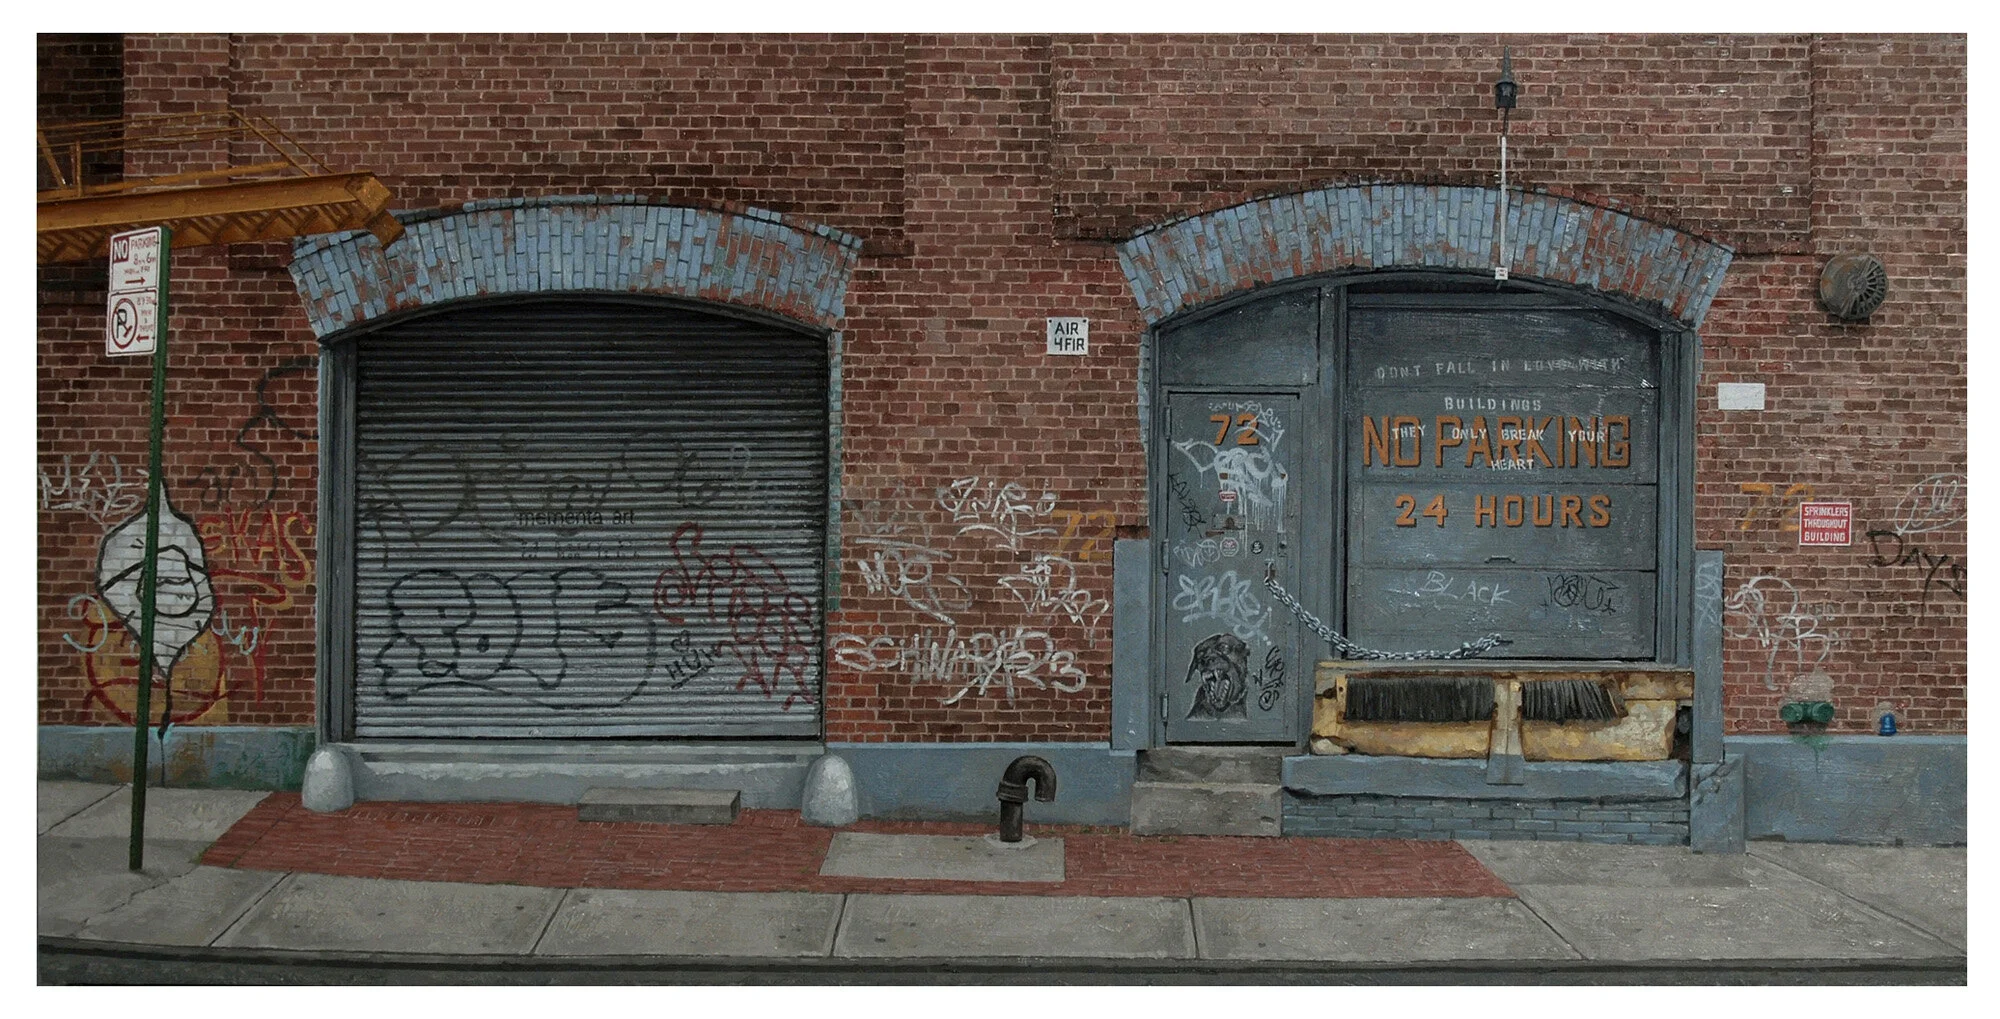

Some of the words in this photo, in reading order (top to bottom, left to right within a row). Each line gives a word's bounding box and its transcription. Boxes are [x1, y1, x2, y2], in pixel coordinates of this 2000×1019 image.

[113, 239, 128, 261] NO
[1055, 322, 1079, 335] AIR
[1054, 337, 1085, 351] 4FIR
[1436, 361, 1476, 376] FALL
[1492, 360, 1510, 373] IN
[1444, 397, 1542, 411] BUILDINGS
[1210, 414, 1260, 446] 72
[1392, 425, 1426, 439] THEY
[1451, 427, 1487, 440] ONLY
[1501, 428, 1545, 441] BREAK
[1568, 429, 1606, 443] YOUR
[1363, 415, 1421, 467] NO
[1435, 415, 1631, 468] PARKING
[1491, 458, 1535, 471] HEART
[1394, 494, 1448, 527] 24
[1475, 494, 1612, 528] HOURS
[1741, 483, 1815, 532] 72
[1804, 506, 1849, 517] SPRINKLERS
[613, 509, 635, 525] art
[1803, 518, 1848, 529] THROUGHOUT
[1052, 509, 1116, 560] 72
[1804, 531, 1846, 542] BUILDING
[1420, 570, 1518, 605] BLACK
